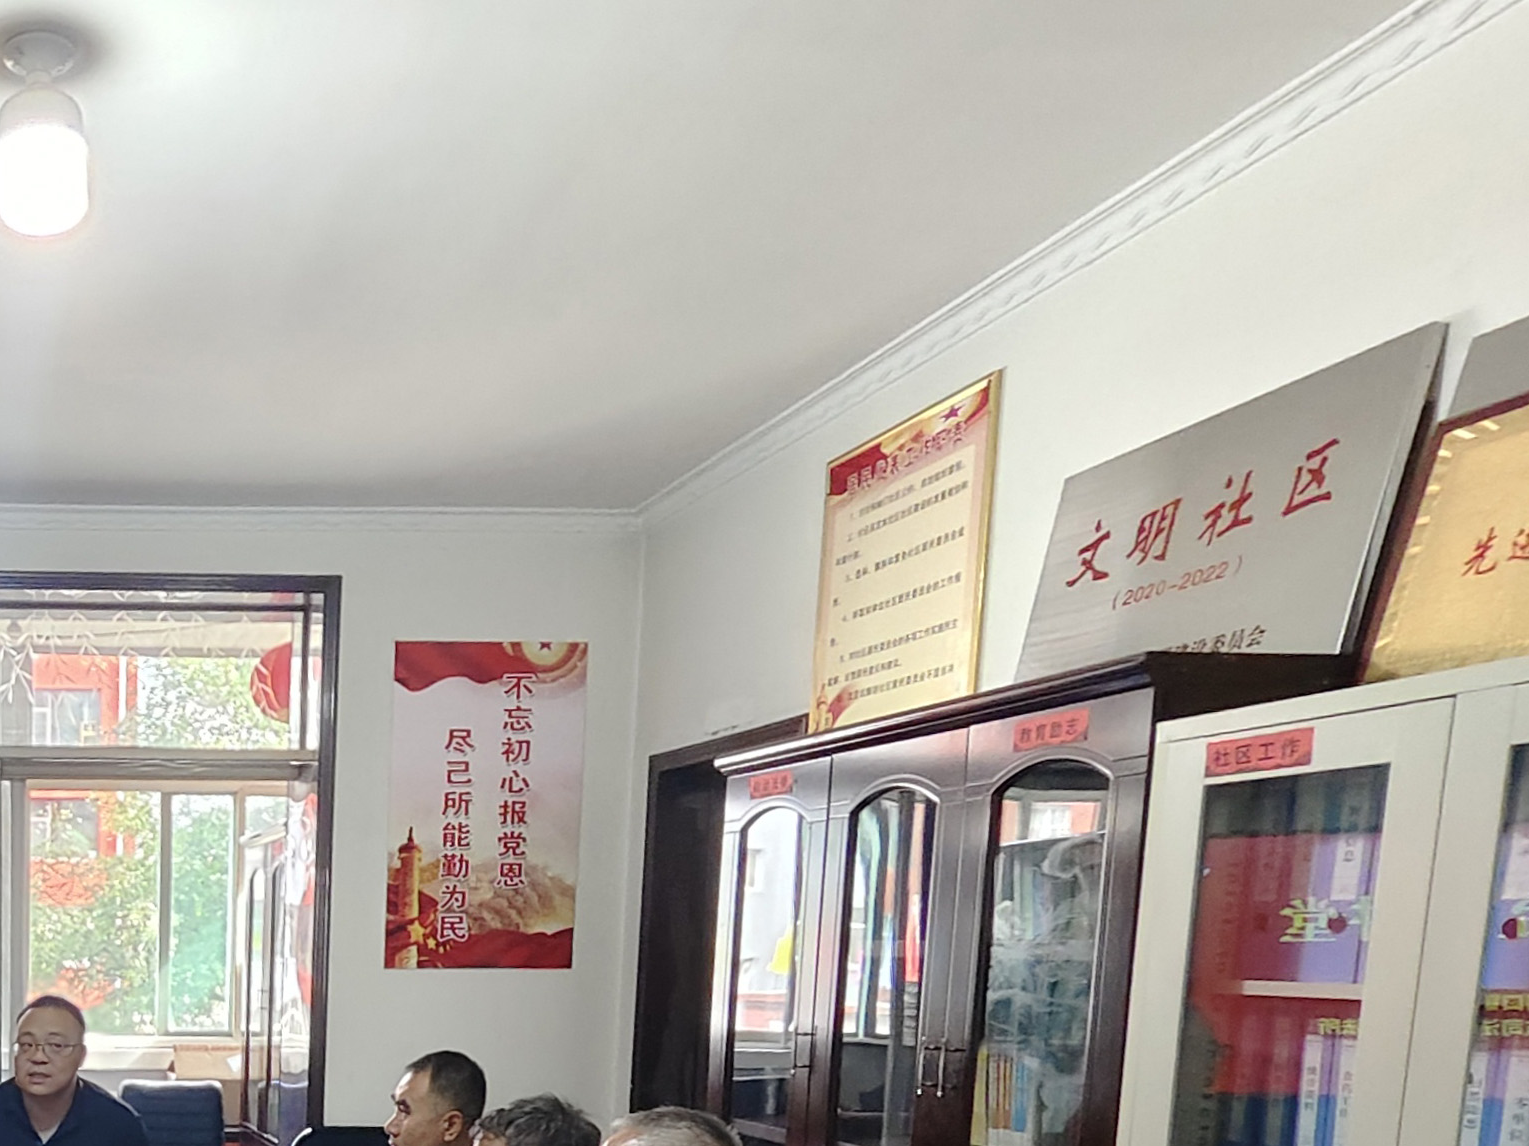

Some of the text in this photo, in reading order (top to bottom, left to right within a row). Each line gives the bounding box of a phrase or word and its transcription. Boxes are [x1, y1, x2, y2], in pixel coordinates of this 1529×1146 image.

[1065, 438, 1341, 588] 文明社区
[437, 728, 474, 942] 尽己所能勤为民
[497, 673, 536, 888] 不忘初心报党恩
[1212, 736, 1303, 768] 社区工作
